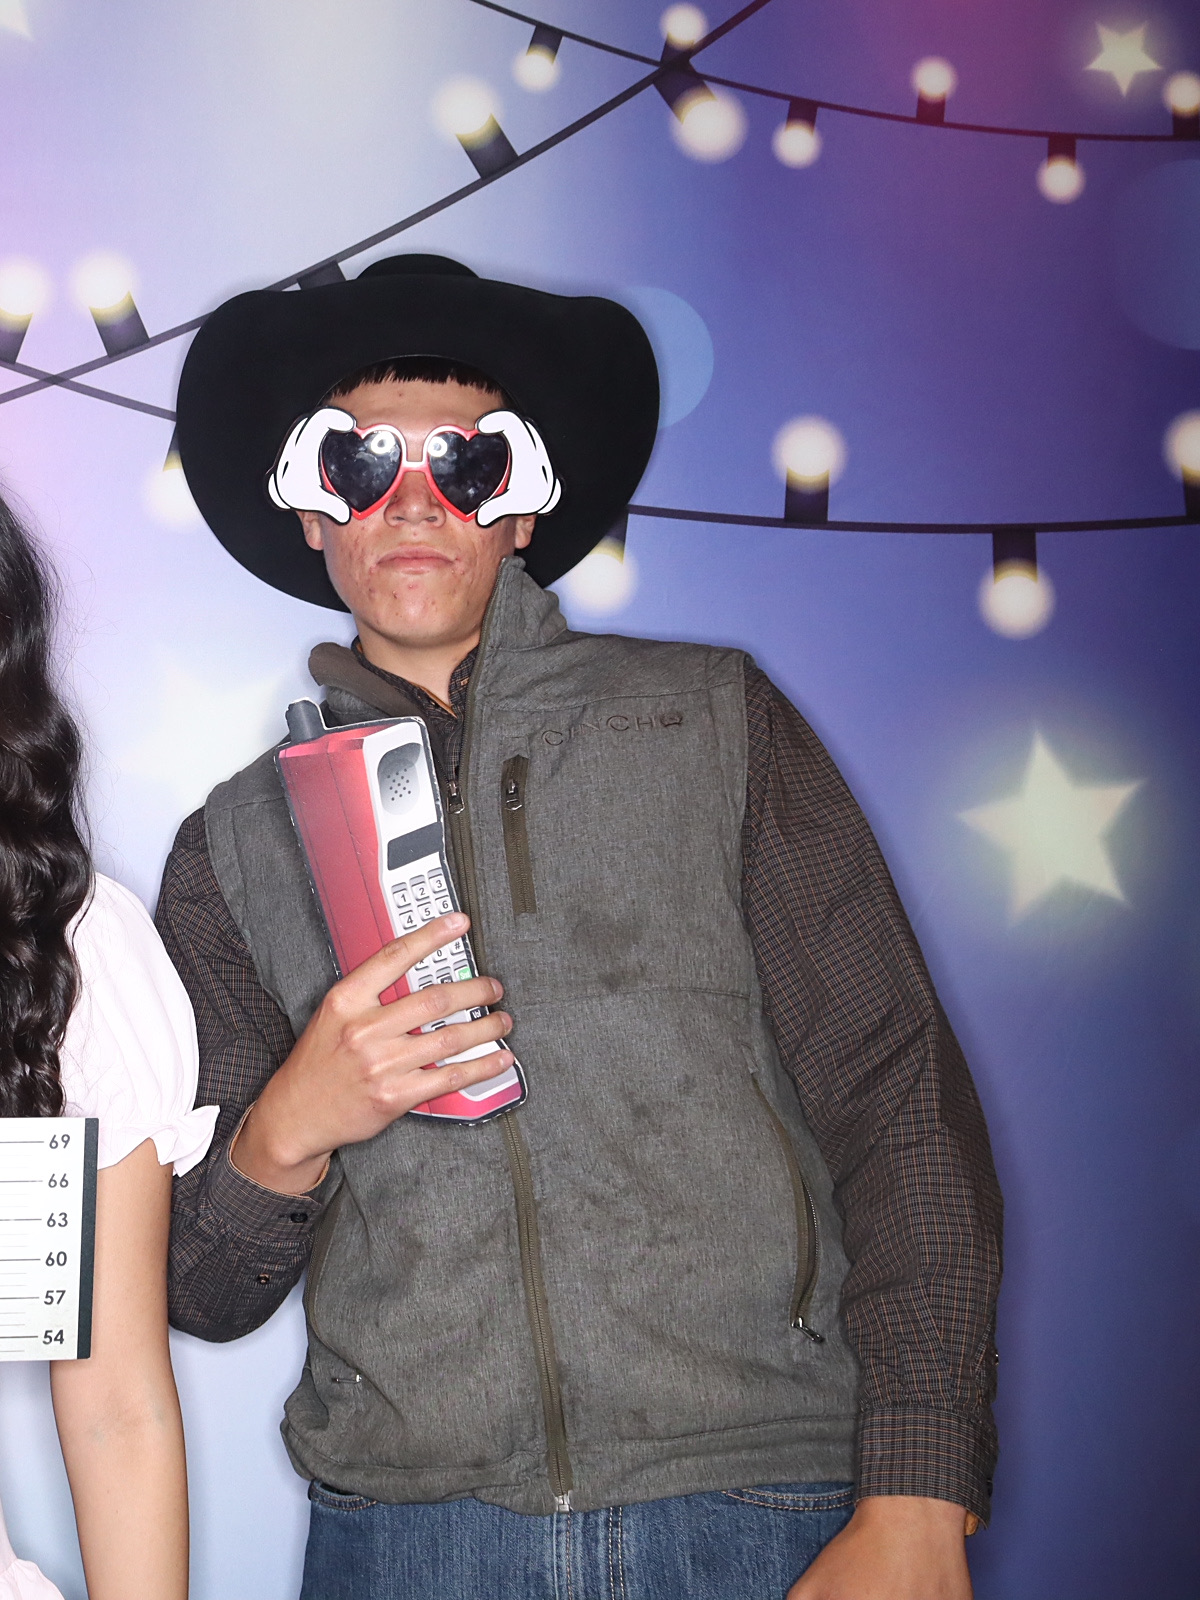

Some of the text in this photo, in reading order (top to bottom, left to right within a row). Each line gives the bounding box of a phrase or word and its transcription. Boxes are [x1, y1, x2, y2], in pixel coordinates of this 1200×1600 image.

[400, 879, 443, 903] 1 2 3
[406, 900, 449, 925] 4 5 6
[49, 1133, 71, 1149] 69
[48, 1173, 69, 1188] 66
[46, 1212, 69, 1228] 63
[45, 1251, 68, 1267] 60
[43, 1290, 67, 1305] 57
[42, 1329, 65, 1345] 54
